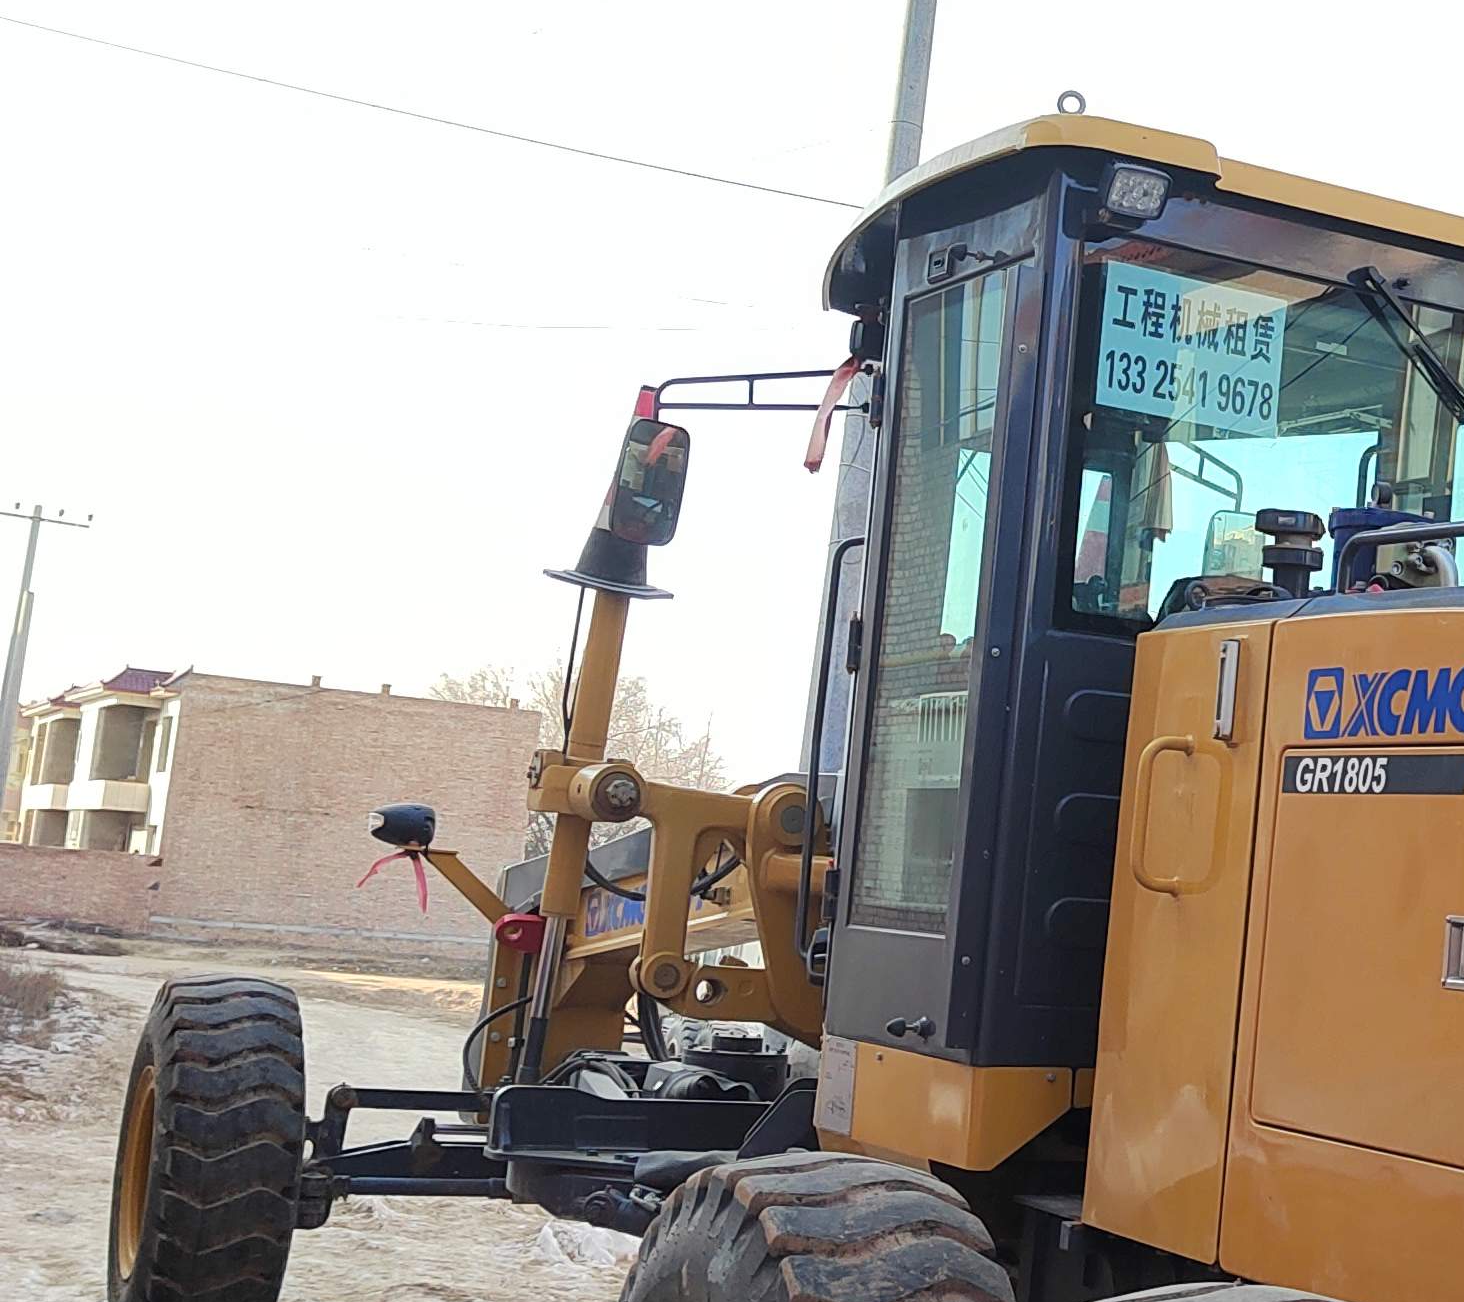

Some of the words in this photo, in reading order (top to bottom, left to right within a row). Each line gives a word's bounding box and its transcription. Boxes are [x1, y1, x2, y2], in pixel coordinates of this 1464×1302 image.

[1112, 285, 1275, 364] 工程机械租赁
[1105, 349, 1147, 394] 133
[1152, 360, 1208, 409] 2541
[1217, 374, 1273, 421] 9678
[1296, 757, 1388, 793] GR1805
